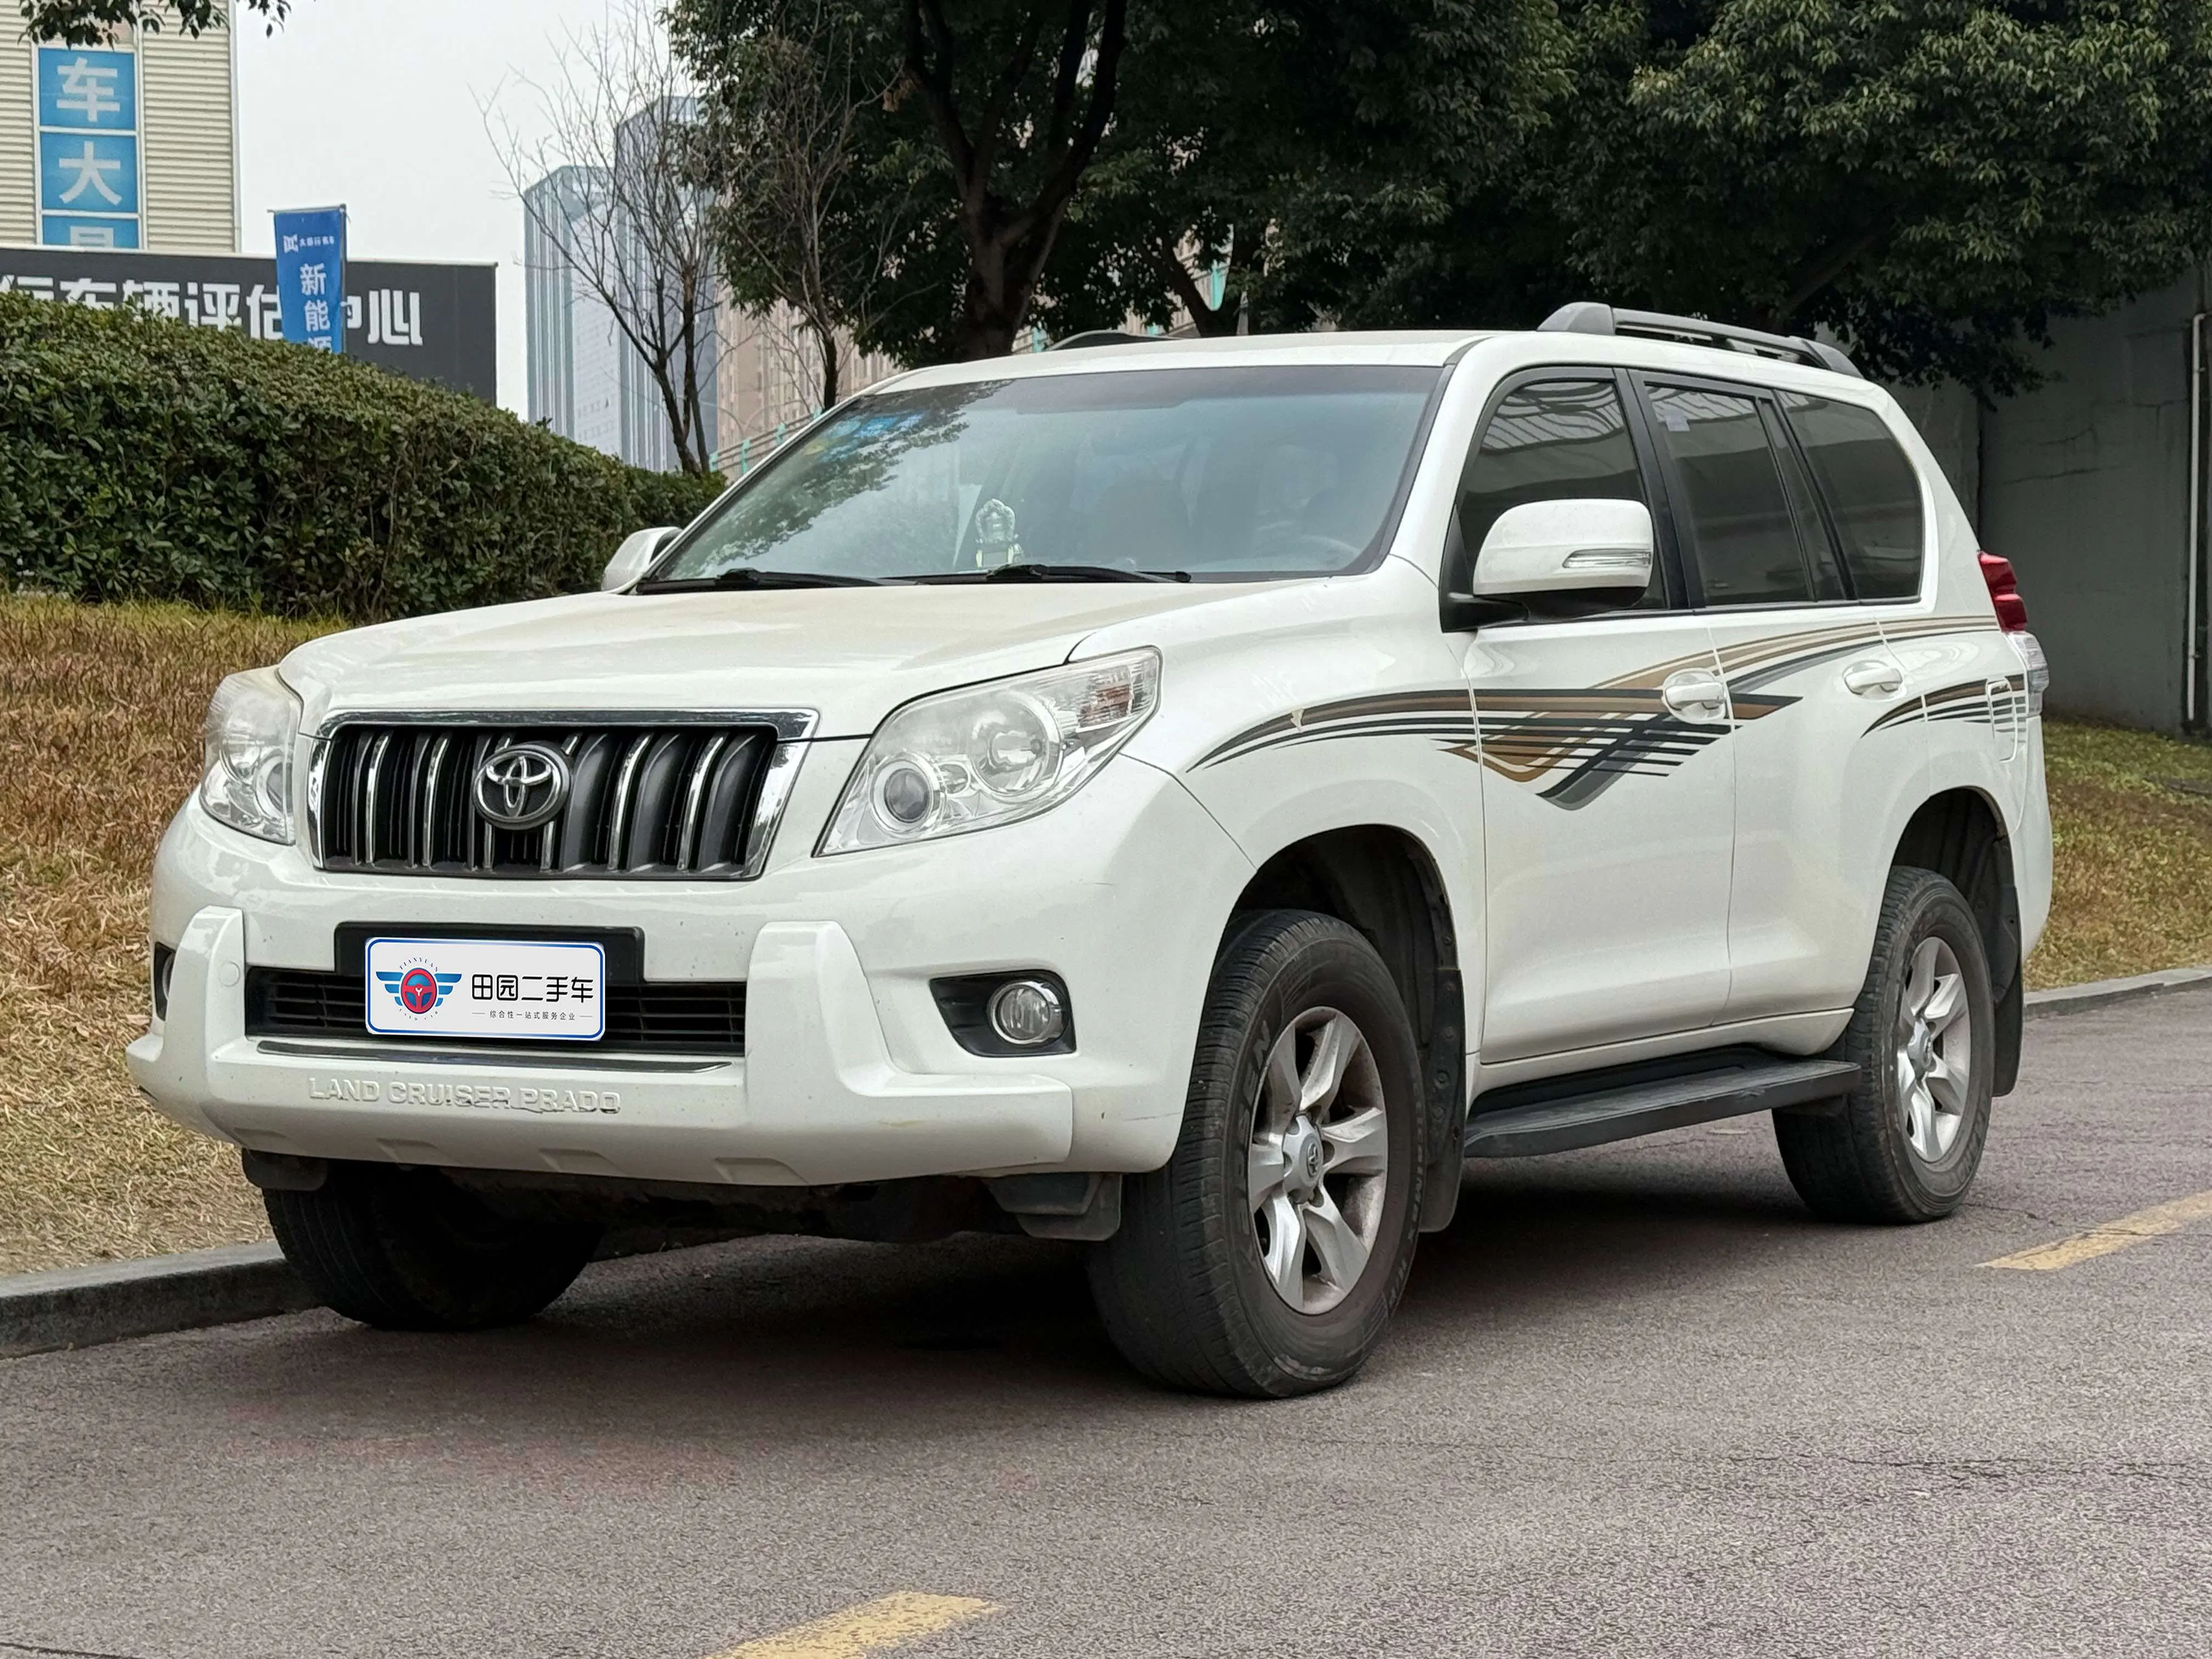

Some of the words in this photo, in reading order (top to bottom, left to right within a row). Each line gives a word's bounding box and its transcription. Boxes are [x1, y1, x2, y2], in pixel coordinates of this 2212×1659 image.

[309, 1077, 380, 1102] LAND
[388, 1081, 511, 1109] CRUISER
[519, 1087, 622, 1115] PRADO
